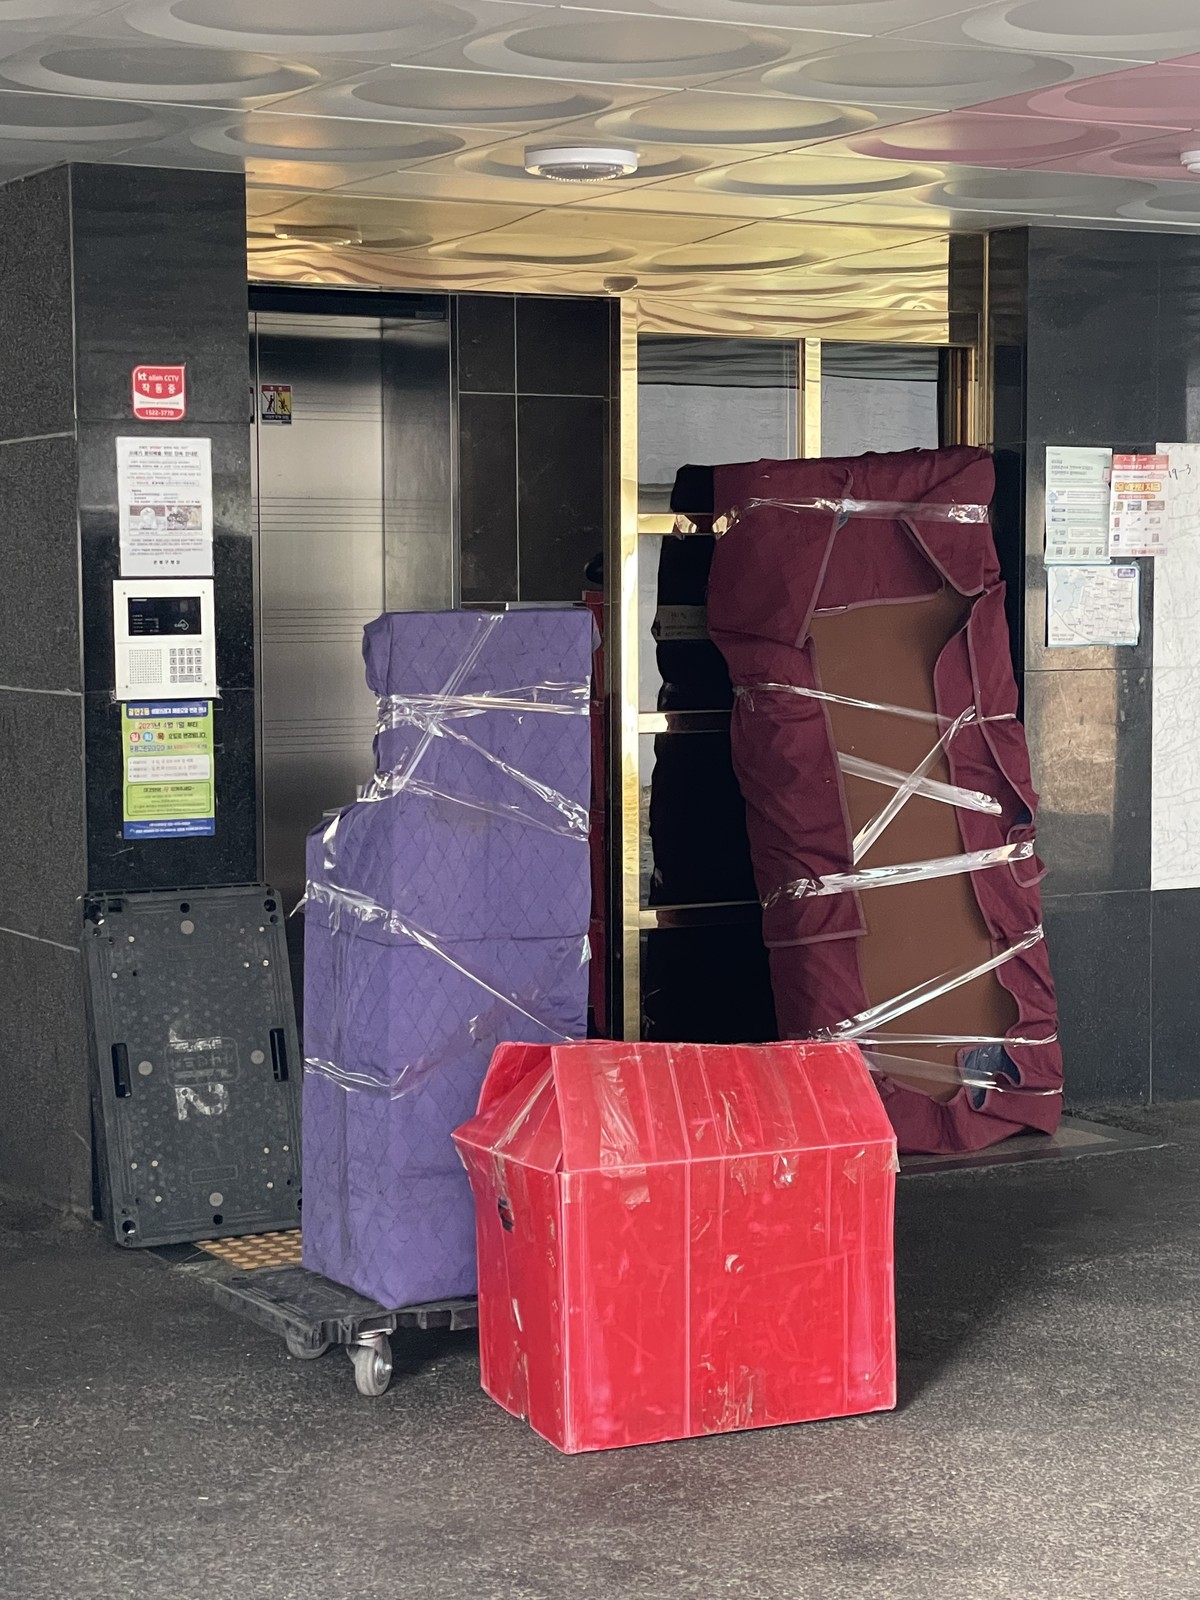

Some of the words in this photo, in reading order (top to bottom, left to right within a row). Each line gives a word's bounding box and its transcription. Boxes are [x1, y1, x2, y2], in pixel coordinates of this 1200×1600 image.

[137, 372, 147, 381] kt
[142, 383, 176, 394] 작동중
[1168, 463, 1192, 481] 19-3
